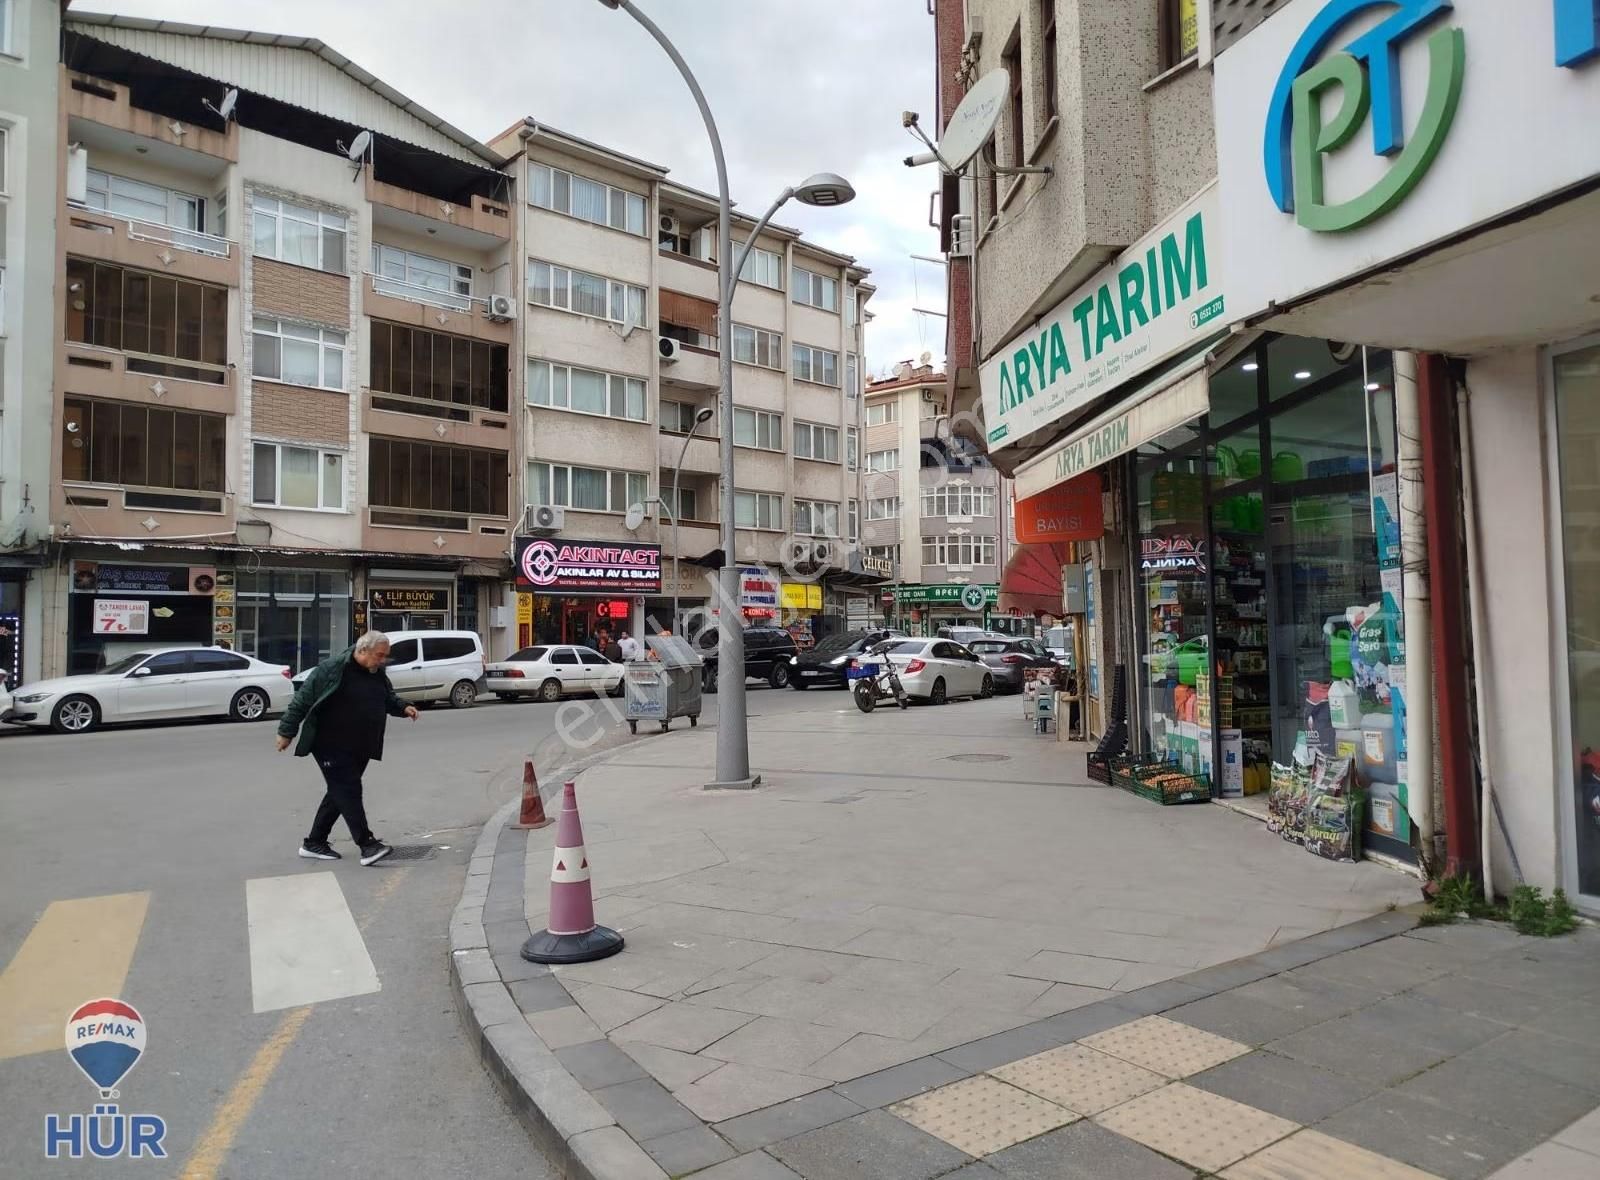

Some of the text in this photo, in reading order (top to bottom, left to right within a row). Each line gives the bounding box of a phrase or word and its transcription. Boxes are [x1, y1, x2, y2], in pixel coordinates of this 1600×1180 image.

[1000, 211, 1208, 416] ARYA TARIM
[1056, 415, 1129, 480] ARYA TARIM
[557, 567, 604, 578] AKINLAR
[606, 569, 620, 578] AV
[621, 570, 629, 578] &
[558, 545, 660, 565] AKINTACT
